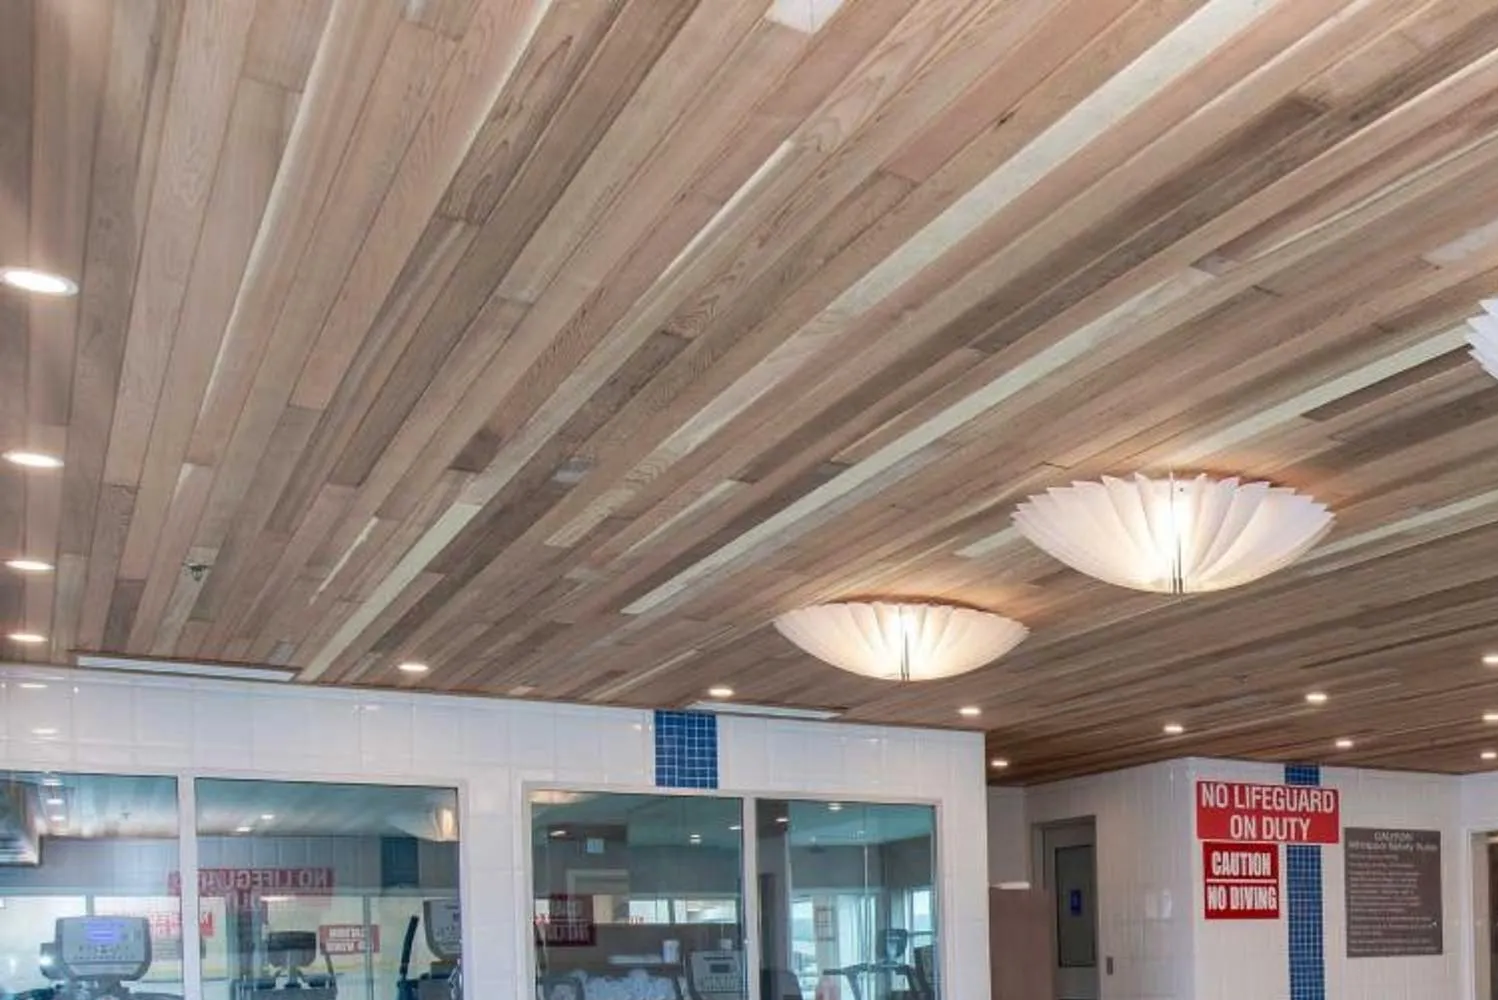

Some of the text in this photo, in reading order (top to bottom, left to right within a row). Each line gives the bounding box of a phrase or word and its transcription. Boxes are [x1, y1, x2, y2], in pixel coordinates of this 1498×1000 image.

[1201, 783, 1334, 814] NO LIFEGUARD
[1230, 814, 1311, 841] ON DUTY
[1211, 851, 1271, 877] CAUTION
[1206, 885, 1278, 911] NO DIVING
